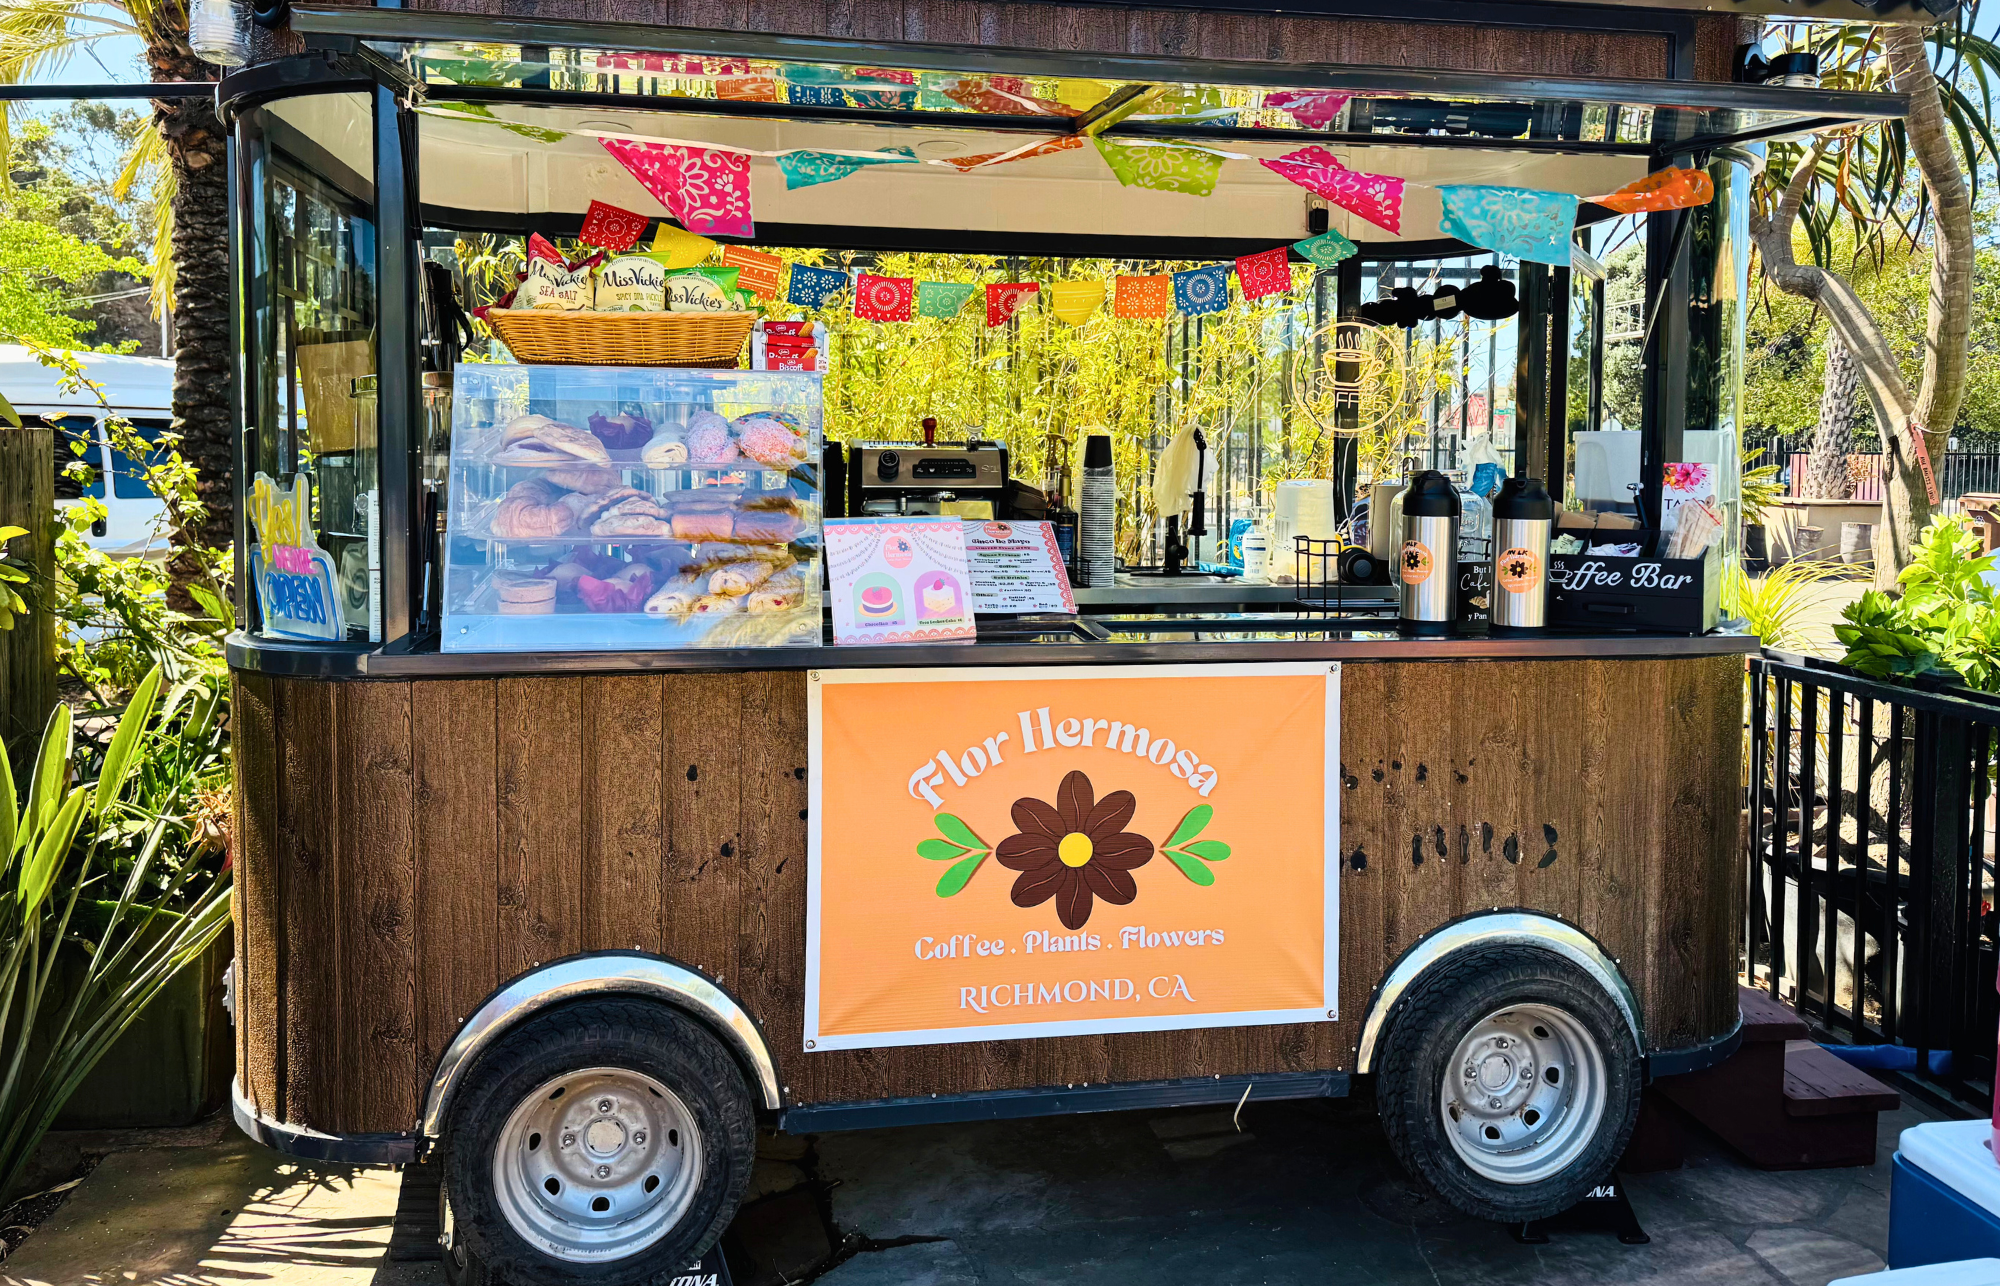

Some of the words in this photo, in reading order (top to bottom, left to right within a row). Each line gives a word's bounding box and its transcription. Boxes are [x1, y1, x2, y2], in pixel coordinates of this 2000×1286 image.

[602, 270, 634, 288] Miss
[628, 266, 665, 292] Vickie'
[539, 286, 555, 298] SEA
[558, 290, 578, 301] SALT
[616, 292, 632, 301] SPICY
[681, 286, 723, 311] Vickie's
[779, 362, 804, 371] Biscoff
[1473, 565, 1487, 574] But
[1630, 562, 1693, 590] Bar
[265, 572, 327, 625] OPEN
[908, 731, 1010, 810] Flor
[1017, 706, 1218, 797] Hermosa
[914, 933, 1005, 960] Coffee
[1022, 930, 1101, 954] Plants
[1119, 925, 1225, 950] Flowers
[959, 978, 1141, 1013] RICHMOND,
[1148, 974, 1197, 1002] CA
